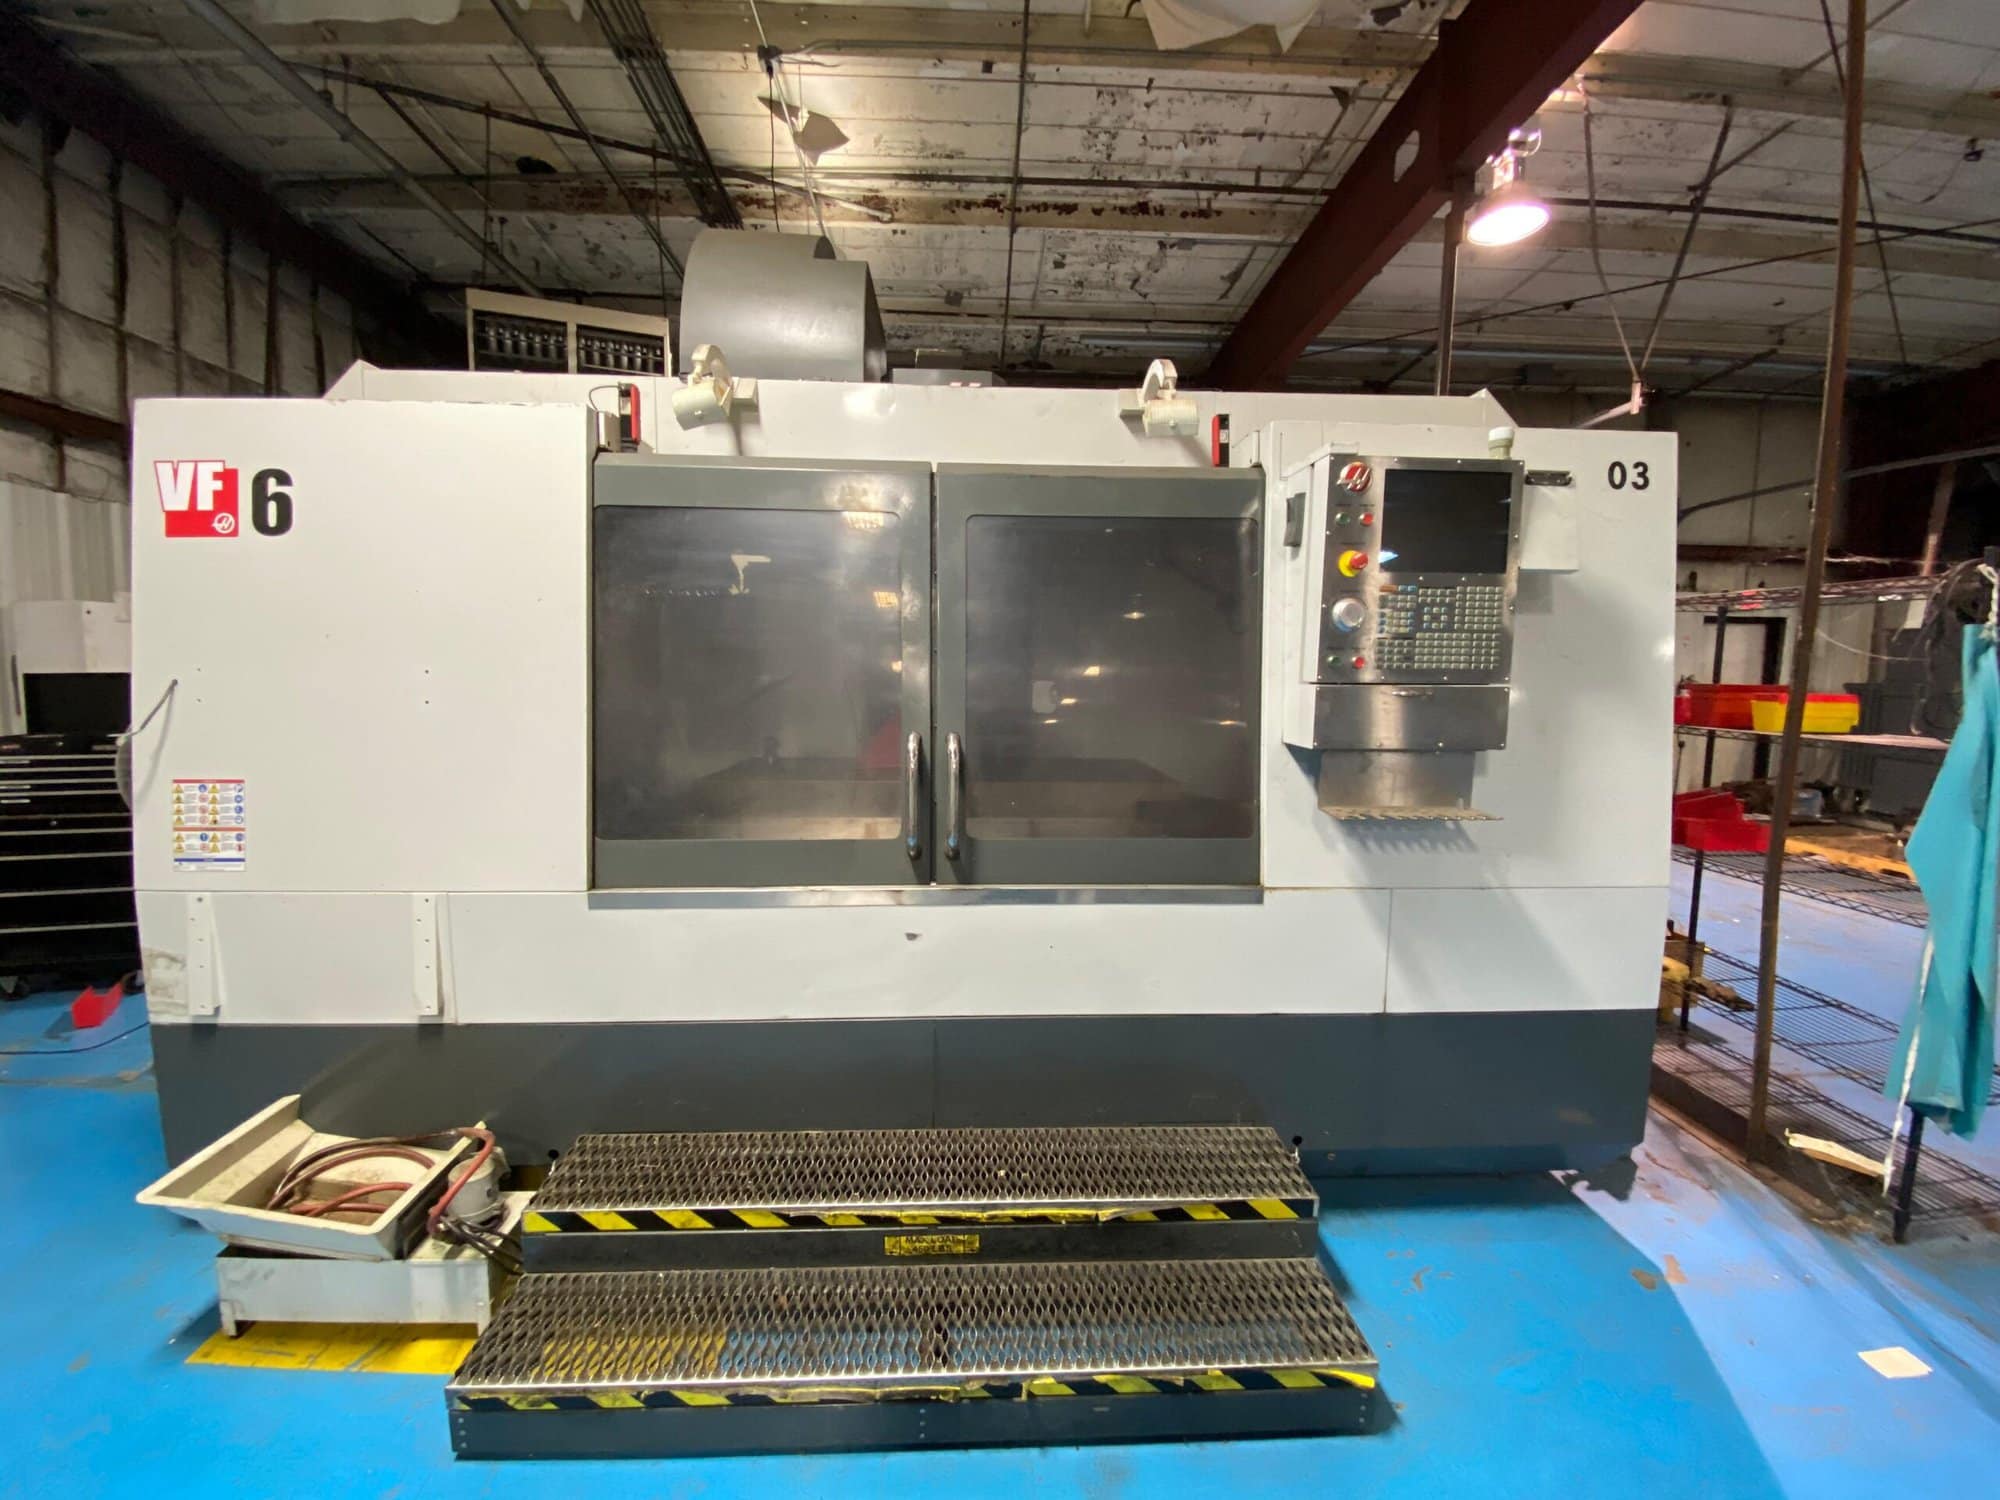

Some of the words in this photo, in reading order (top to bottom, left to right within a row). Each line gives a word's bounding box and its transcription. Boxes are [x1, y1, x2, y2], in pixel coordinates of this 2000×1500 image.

[154, 460, 226, 512] VF
[251, 468, 294, 537] 6
[1607, 461, 1650, 491] 03
